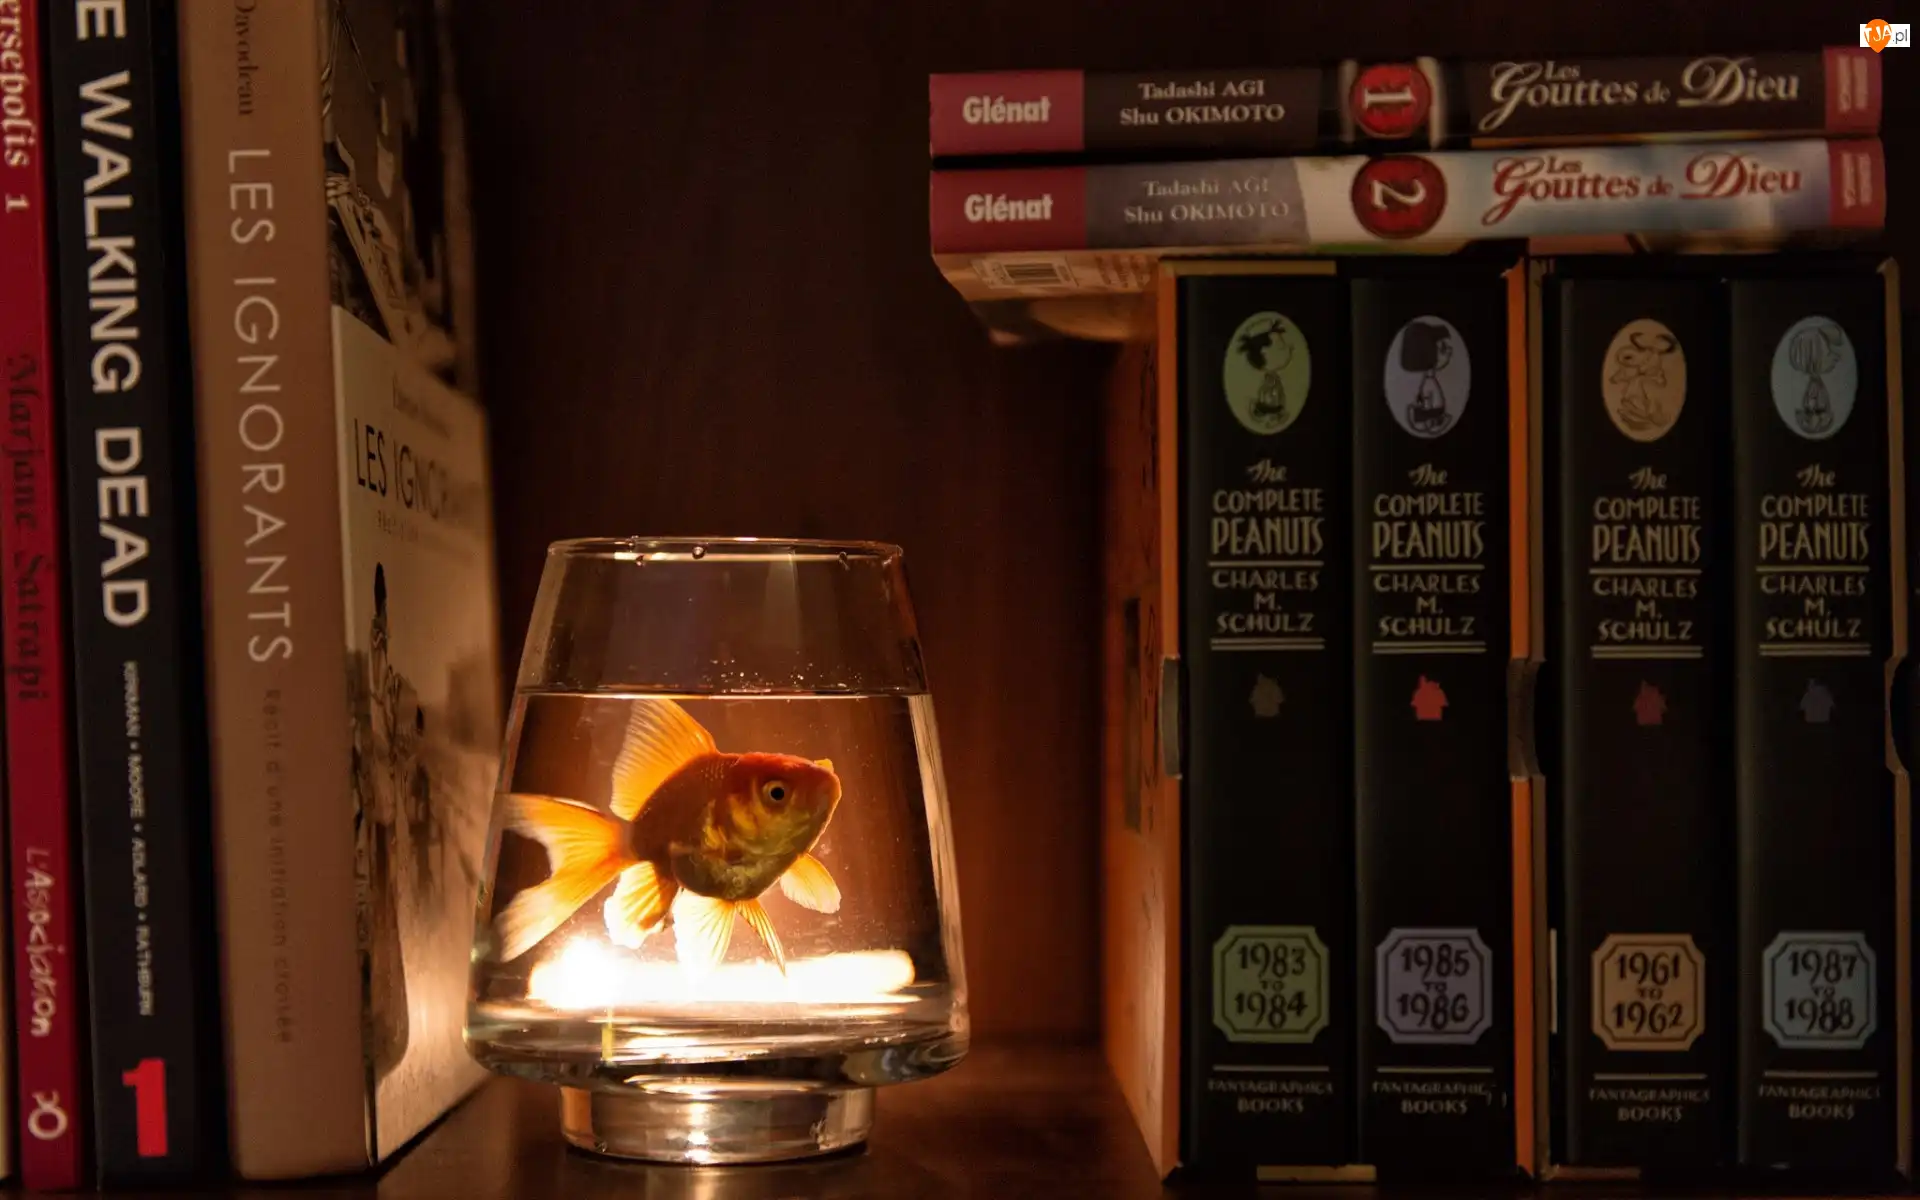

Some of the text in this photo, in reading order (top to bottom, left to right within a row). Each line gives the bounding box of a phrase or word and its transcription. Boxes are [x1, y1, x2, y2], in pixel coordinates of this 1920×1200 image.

[1544, 60, 1581, 81] Les
[1138, 79, 1266, 101] Tadashi AGI
[1363, 85, 1417, 110] 1
[1478, 61, 1640, 132] Gouttes
[1643, 80, 1671, 105] de
[1676, 55, 1801, 108] Dieu
[962, 95, 1052, 125] Glénat
[1119, 103, 1286, 127] Shu OKIMOTO
[1546, 156, 1583, 174] Les
[1143, 176, 1270, 198] Tadashi AGI
[1370, 178, 1428, 213] 2
[1481, 156, 1642, 227] Gouttes
[1647, 177, 1673, 197] de
[1680, 151, 1801, 200] Dieu
[964, 192, 1054, 224] Glénat
[1124, 200, 1290, 226] Shu OKIMOTO
[79, 70, 143, 394] WALKING
[228, 149, 294, 662] LES IGNORANTS
[354, 418, 387, 497] LES
[1246, 457, 1289, 484] The
[1407, 462, 1449, 487] The
[1628, 465, 1668, 491] The
[1796, 462, 1837, 488] The
[1212, 487, 1326, 514] COMPLETE
[1373, 491, 1486, 518] COMPLETE
[1593, 496, 1701, 521] COMPLETE
[1760, 493, 1870, 519] COMPLETE
[95, 427, 150, 627] DEAD
[1211, 516, 1326, 556] PEANUTS
[1372, 520, 1487, 560] PEANUTS
[1592, 523, 1702, 564] PEANUTS
[1759, 522, 1872, 561] PEANUTS
[1211, 569, 1320, 592] CHARLES
[1373, 573, 1481, 595] CHARLES
[1592, 576, 1698, 598] CHARLES
[1760, 574, 1867, 596] CHARLES
[1253, 592, 1283, 612] M.
[1415, 595, 1445, 615] M.
[1634, 599, 1664, 620] M.
[1804, 597, 1832, 618] M.
[1216, 612, 1314, 633] SCHULZ
[1378, 616, 1476, 638] SCHULZ
[1597, 619, 1694, 641] SCHULZ
[1765, 617, 1862, 639] SCHULZ
[122, 660, 142, 737] KIRKMAN
[127, 753, 146, 818] MOORE
[131, 836, 149, 908] ADLARD
[1238, 942, 1305, 978] 1983
[1401, 943, 1470, 978] 1985
[1616, 952, 1680, 985] 1961
[1788, 949, 1858, 985] 1987
[1260, 980, 1284, 992] TO
[1424, 981, 1448, 993] TO
[1636, 987, 1663, 999] TO
[1811, 986, 1836, 998] TO
[1235, 991, 1308, 1029] 1984
[1397, 993, 1470, 1031] 1986
[1613, 1002, 1684, 1034] 1962
[1784, 998, 1855, 1034] 1988
[122, 1057, 169, 1158] 1
[1237, 1097, 1305, 1114] BOOKS
[1400, 1098, 1469, 1115] BOOKS
[1617, 1105, 1684, 1122] BOOKS
[1788, 1103, 1856, 1120] BOOKS
